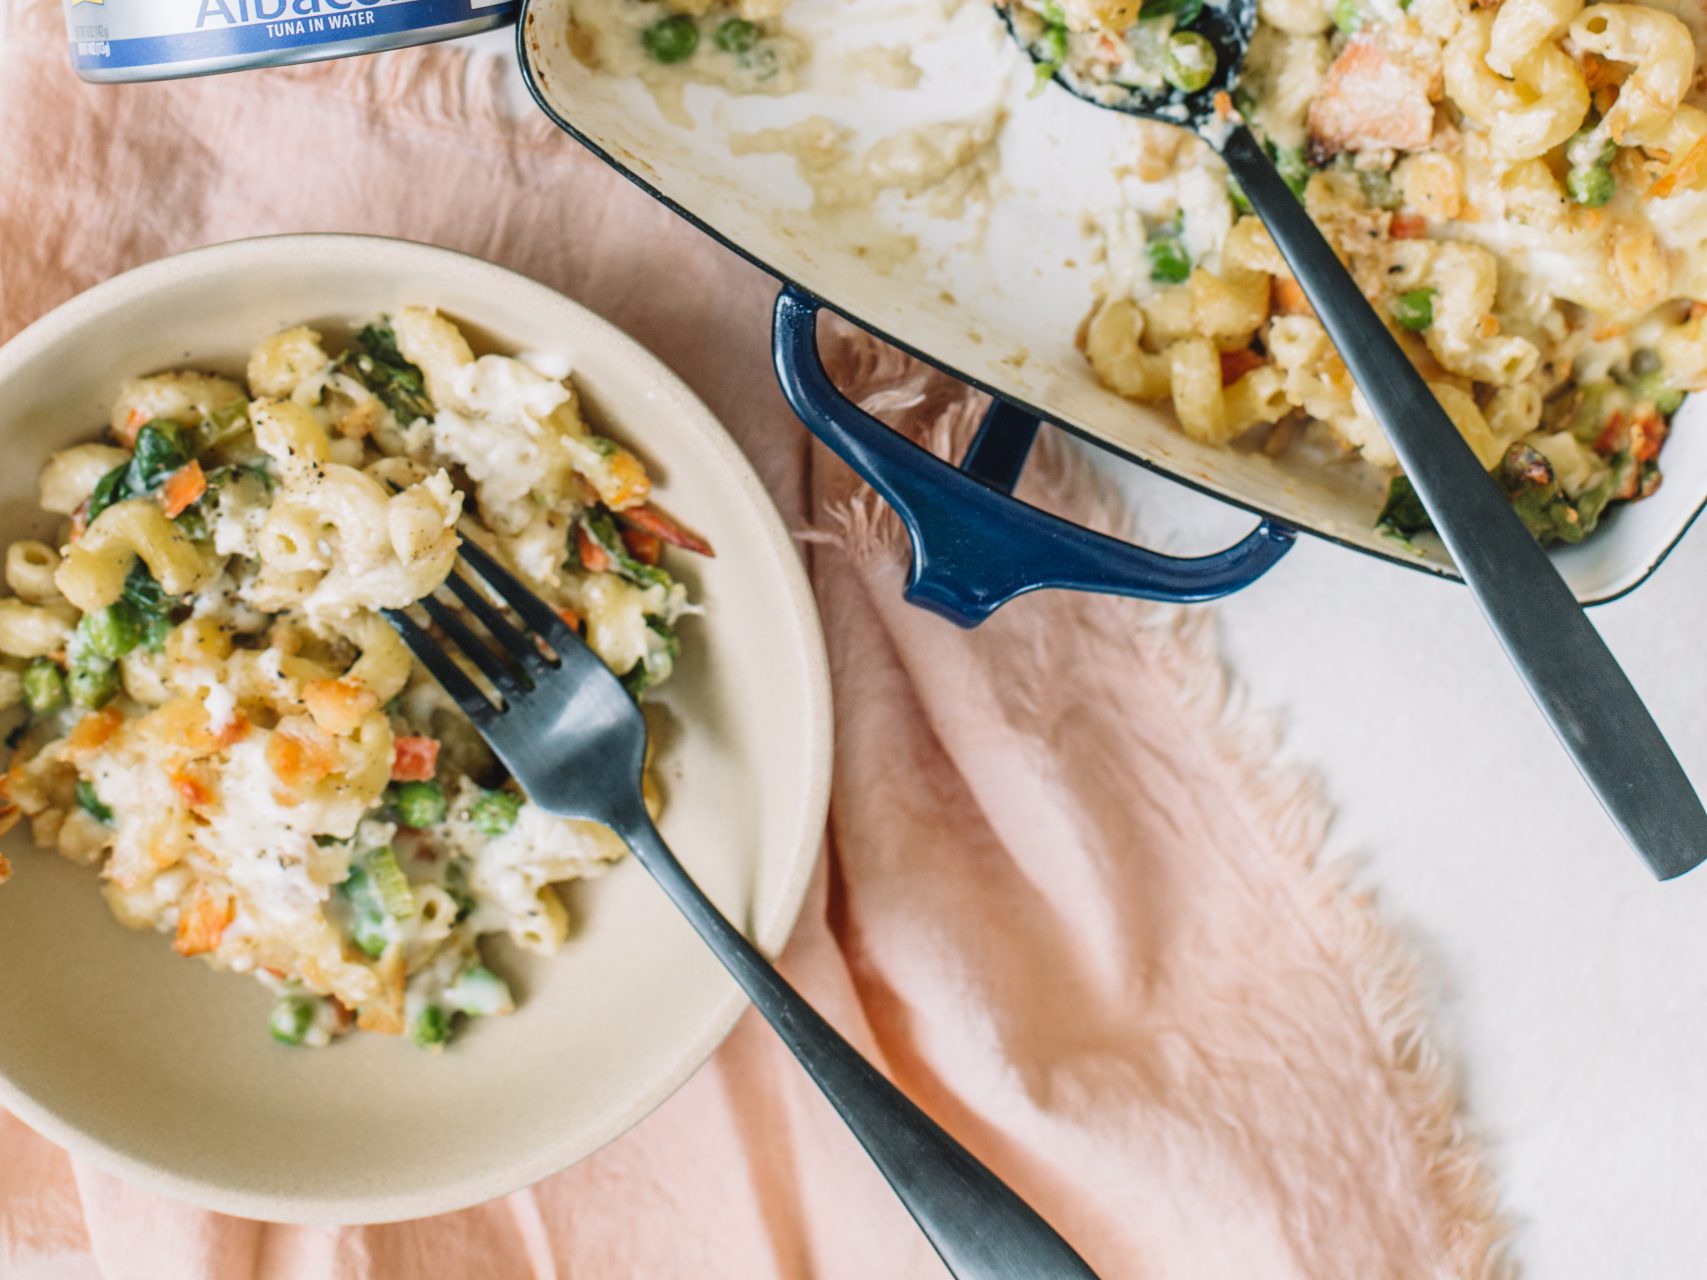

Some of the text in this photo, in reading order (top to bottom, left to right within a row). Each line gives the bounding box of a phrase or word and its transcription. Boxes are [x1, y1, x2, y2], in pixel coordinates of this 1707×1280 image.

[266, 10, 375, 38] TUNA IN WATER
